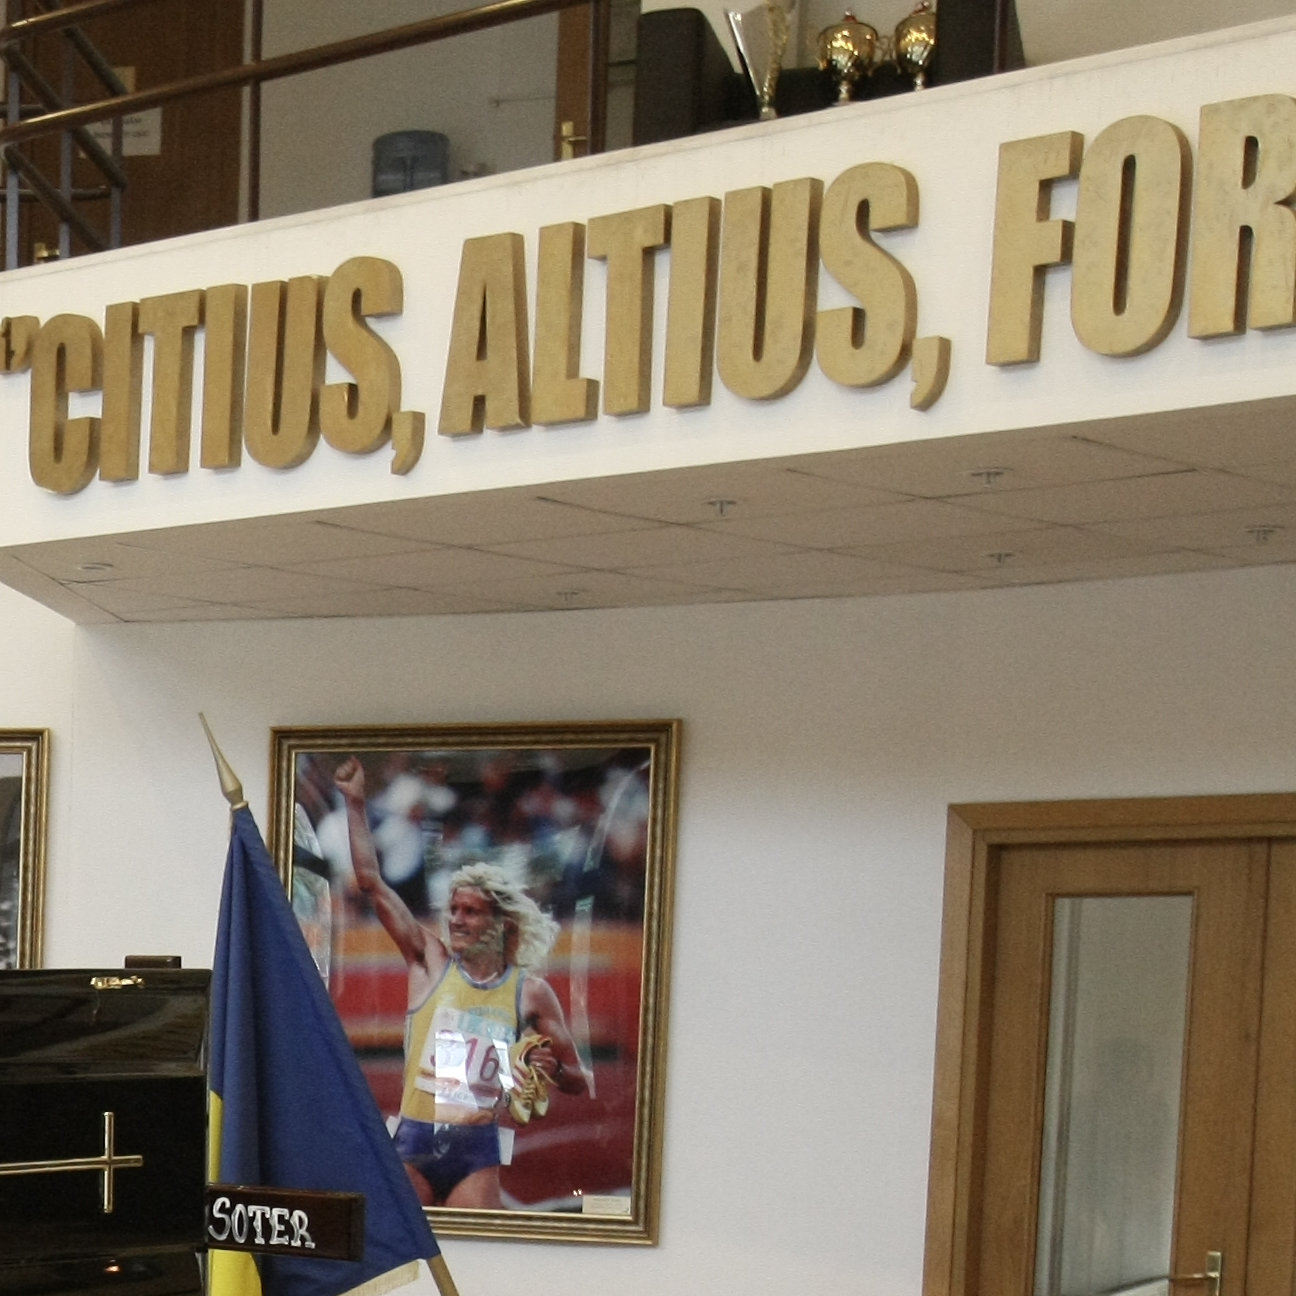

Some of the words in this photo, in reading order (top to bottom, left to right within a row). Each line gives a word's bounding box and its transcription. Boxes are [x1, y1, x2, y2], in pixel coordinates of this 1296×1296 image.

[438, 162, 951, 437] ALTIUS,
[986, 94, 1296, 366] FOR
[208, 1196, 316, 1249] SOTER
